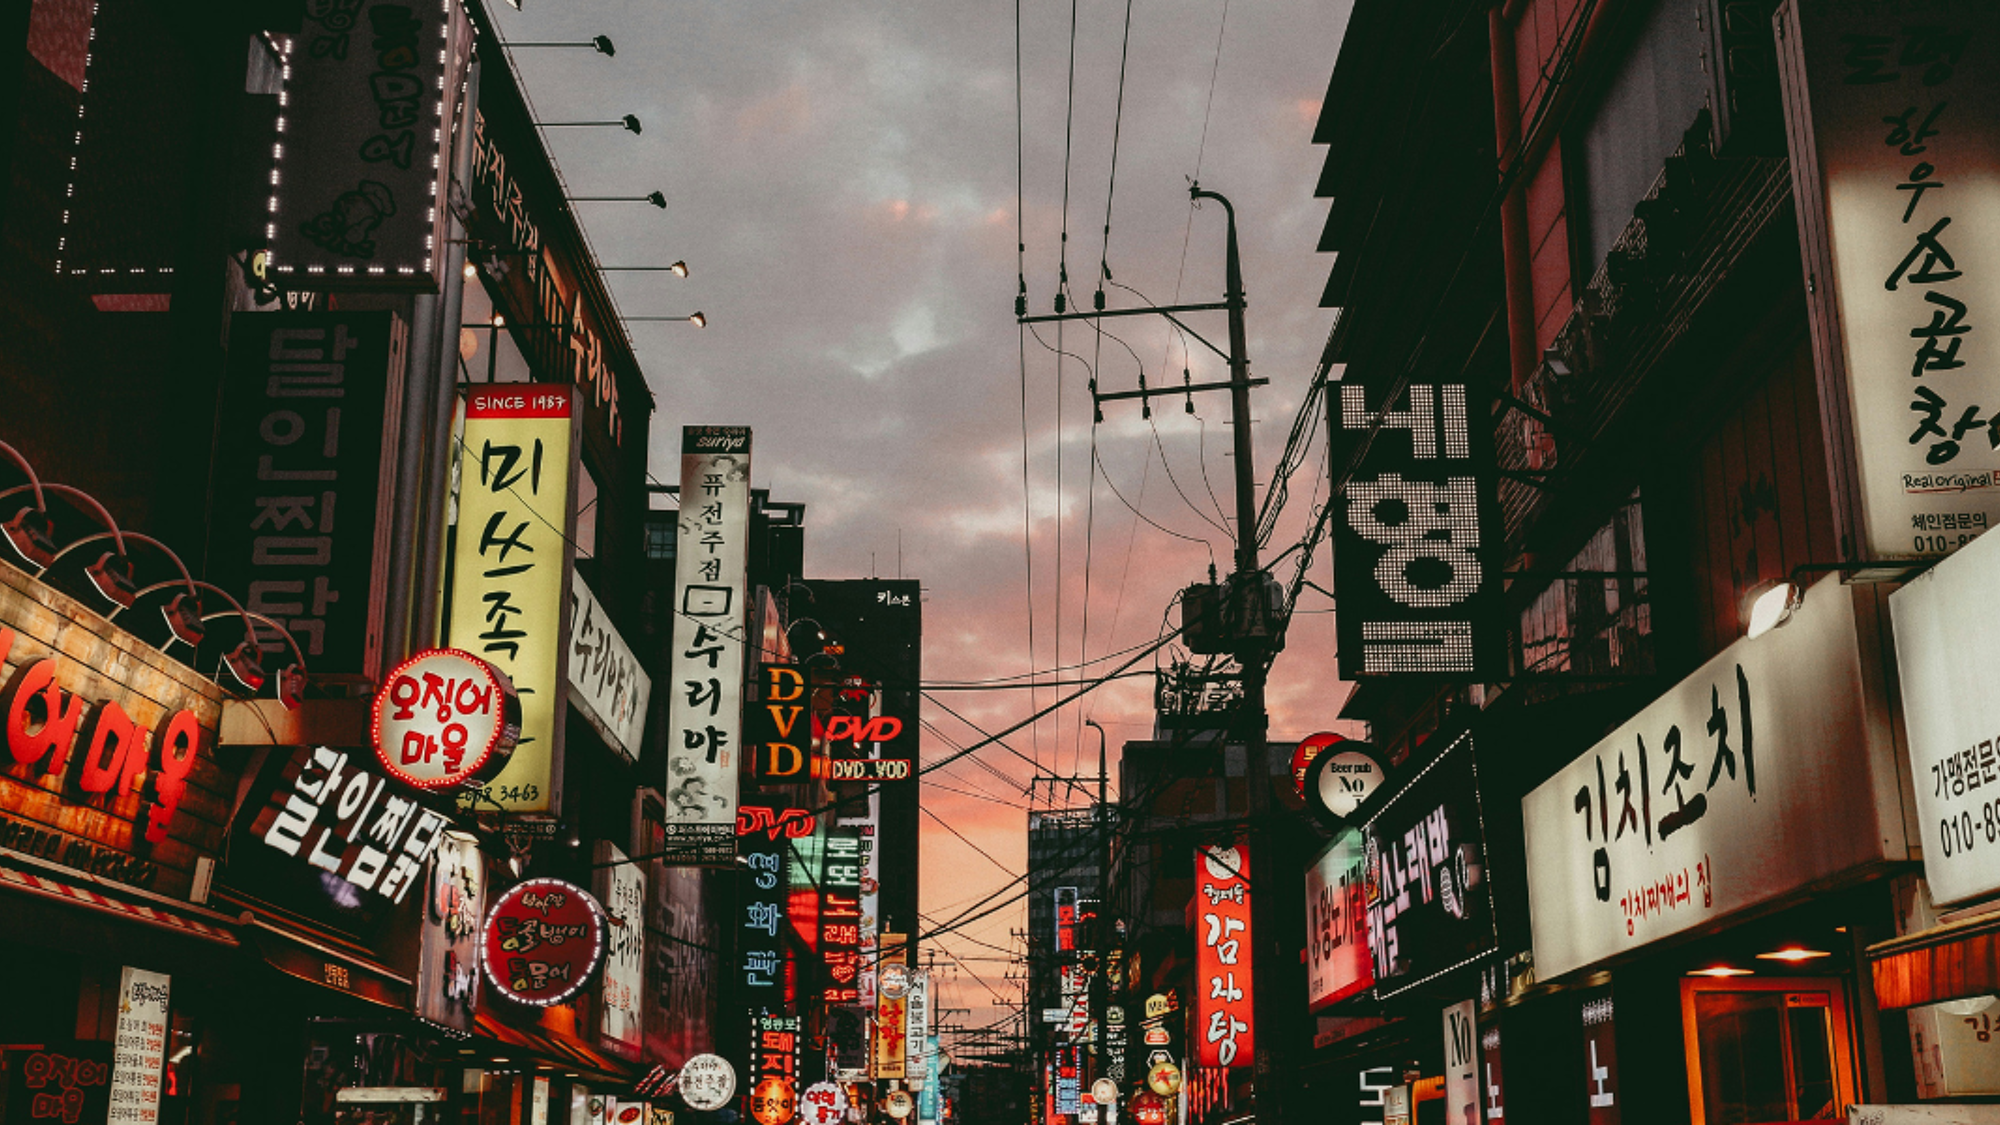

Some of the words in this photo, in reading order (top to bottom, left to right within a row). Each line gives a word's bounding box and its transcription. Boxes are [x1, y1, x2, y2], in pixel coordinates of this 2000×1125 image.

[475, 396, 526, 411] SINCE
[532, 395, 567, 410] 1987
[1903, 474, 1934, 488] Real
[698, 473, 727, 583] 퓨전주점
[1911, 512, 1988, 531] 체인점문의
[390, 672, 493, 722] 오징어
[684, 625, 729, 764] 수리야
[765, 667, 805, 776] DVD
[0, 629, 201, 842] 어마을
[401, 722, 469, 775] 마을
[824, 716, 904, 742] DVD
[501, 783, 540, 803] 3463
[1331, 762, 1353, 773] Beer
[1354, 762, 1372, 775] pub
[1574, 664, 1757, 903] 김치조치
[1931, 737, 2000, 801] 가맹점문
[736, 805, 817, 841] DVD
[1696, 853, 1712, 908] 집
[1204, 912, 1248, 1066] 감자탕
[1449, 1010, 1472, 1067] No
